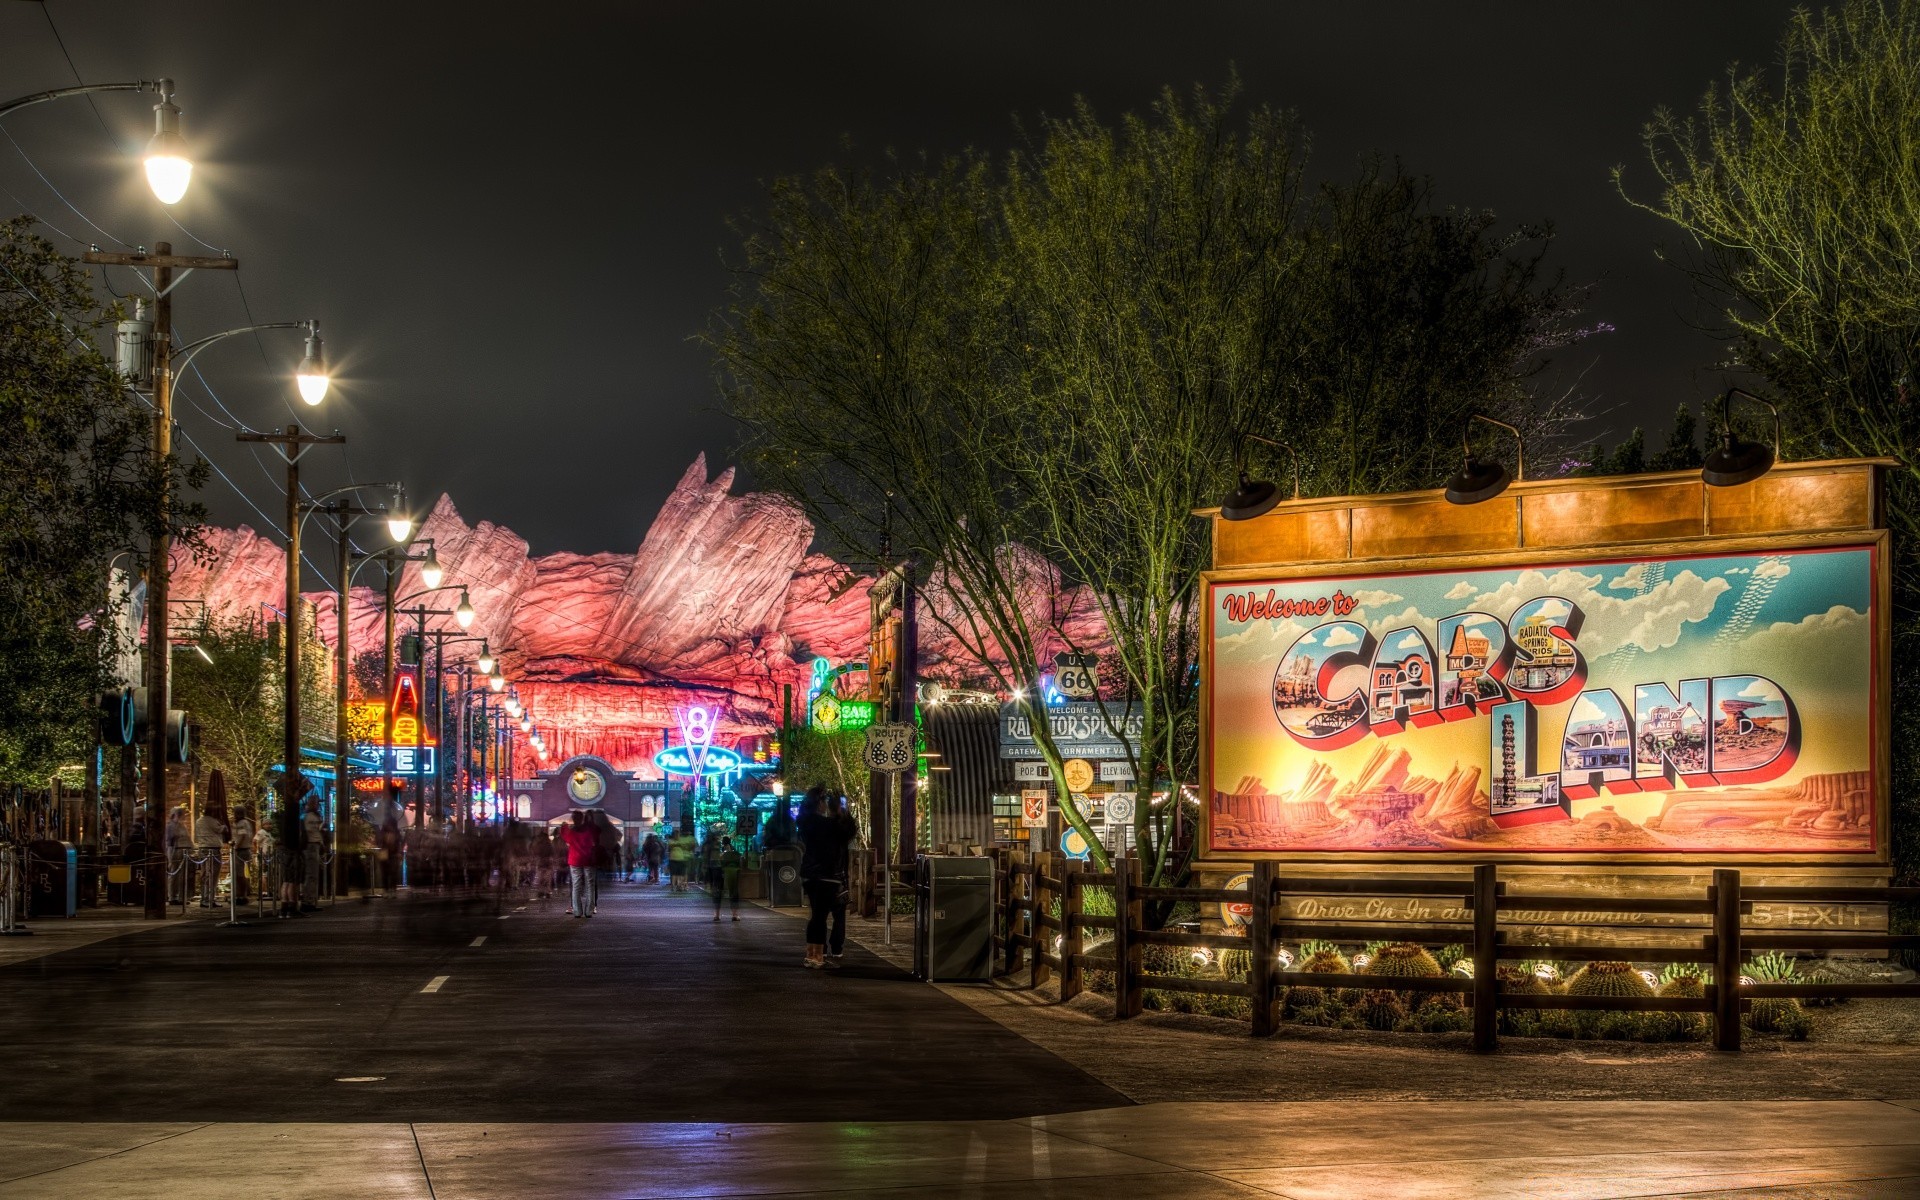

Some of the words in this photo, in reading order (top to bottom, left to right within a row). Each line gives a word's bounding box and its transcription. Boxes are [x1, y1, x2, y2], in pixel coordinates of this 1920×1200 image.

[1222, 589, 1331, 622] Welcome
[1332, 589, 1359, 616] to
[1519, 625, 1552, 640] RADIATO
[1524, 638, 1548, 648] SPRINGS
[1528, 647, 1553, 655] RIOS
[1272, 596, 1587, 750] CARS
[1061, 671, 1091, 689] 66
[1049, 706, 1088, 715] WELCOME
[1092, 707, 1101, 715] to
[1653, 711, 1670, 720] TOW
[1648, 721, 1677, 731] MATER
[874, 728, 906, 738] ROUTE
[871, 740, 908, 765] 66
[1008, 748, 1042, 756] GATEWA
[1064, 747, 1110, 756] ORNAMENT
[1489, 674, 1801, 829] LAND
[1037, 766, 1049, 776] 12
[739, 815, 754, 828] 25
[1297, 899, 1358, 920] Drive
[1365, 898, 1398, 920] On
[1403, 899, 1434, 920] In
[1440, 906, 1475, 920] an
[1786, 905, 1869, 927] EXIT
